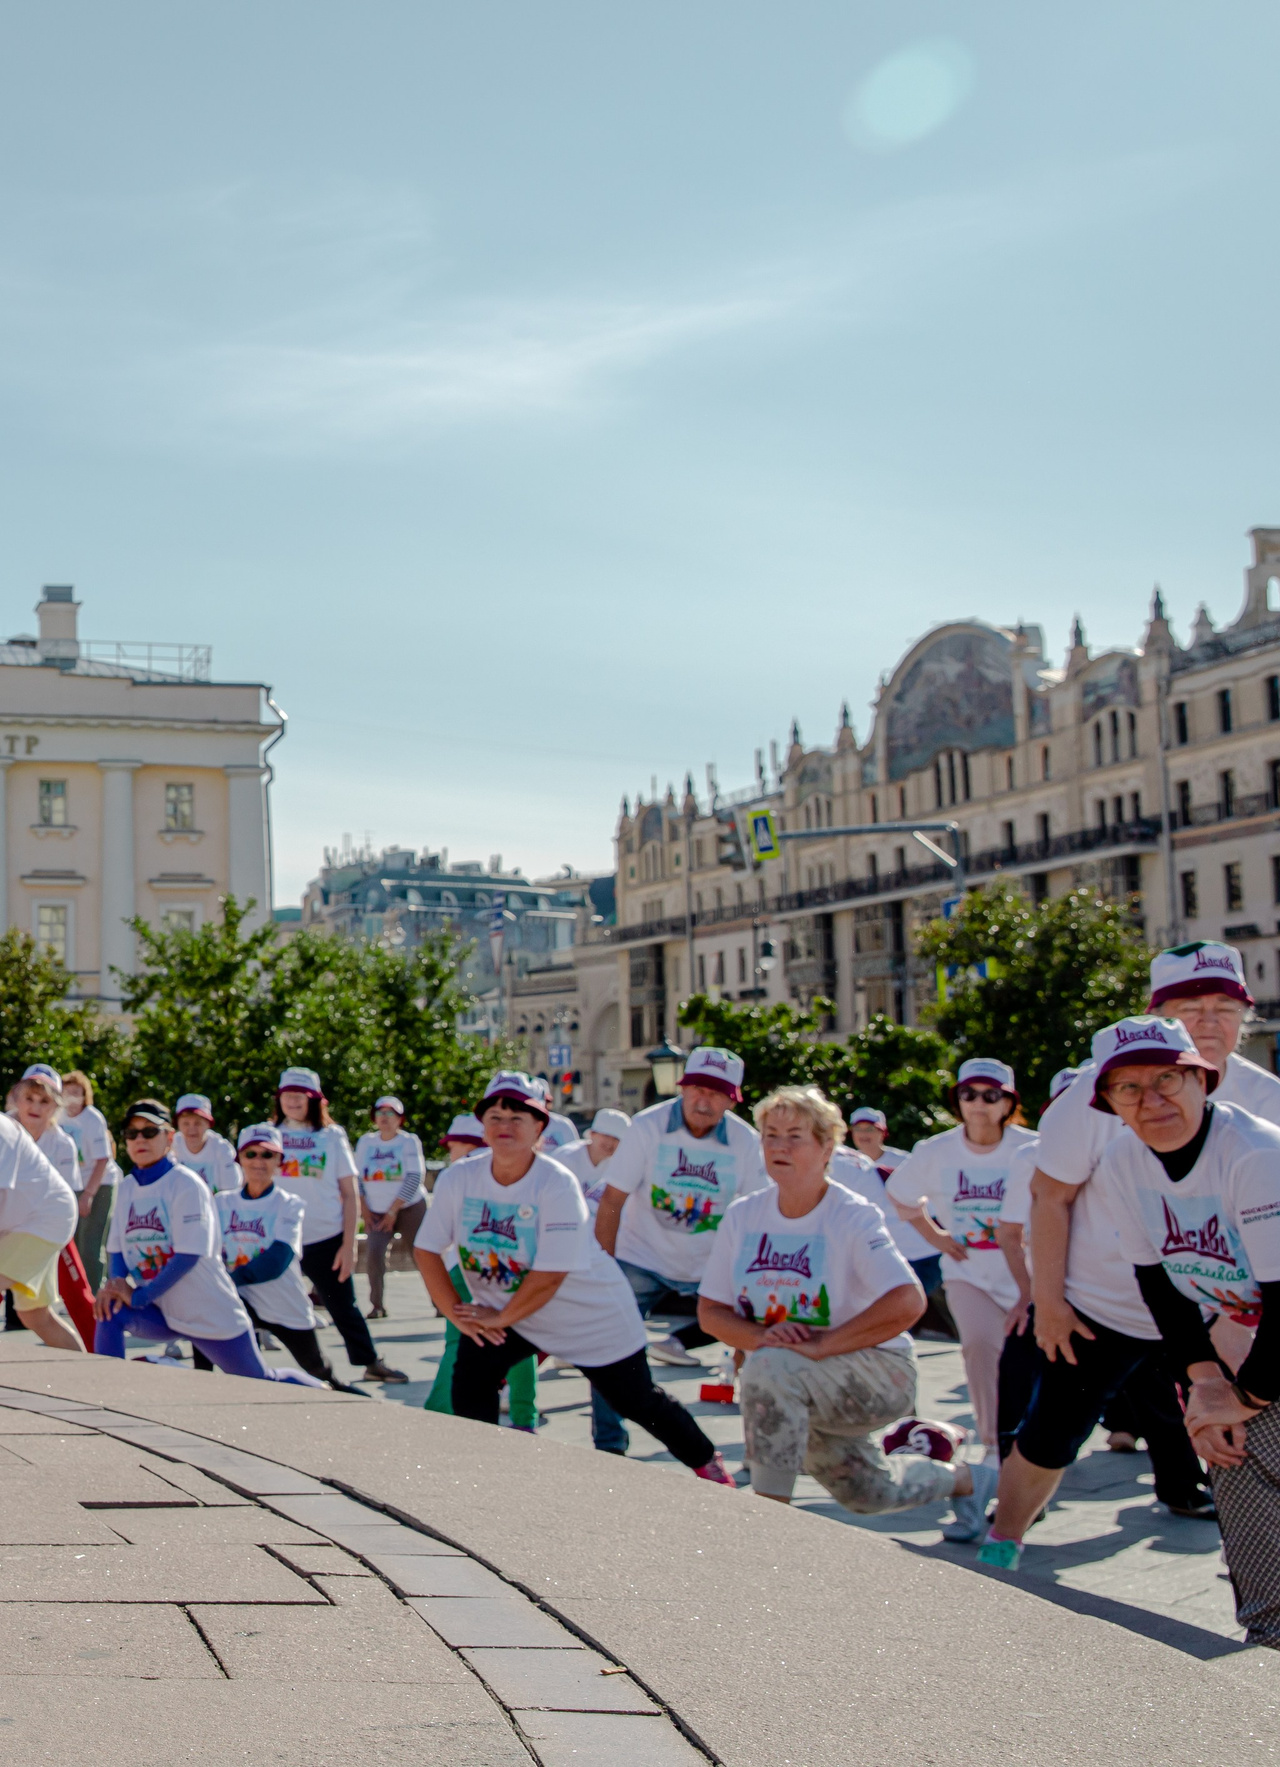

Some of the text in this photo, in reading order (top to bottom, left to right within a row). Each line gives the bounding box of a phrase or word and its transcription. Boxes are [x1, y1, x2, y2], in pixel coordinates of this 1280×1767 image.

[1114, 1025, 1168, 1051] Москва
[1160, 1195, 1237, 1267] Мсква
[746, 1233, 812, 1279] Москва
